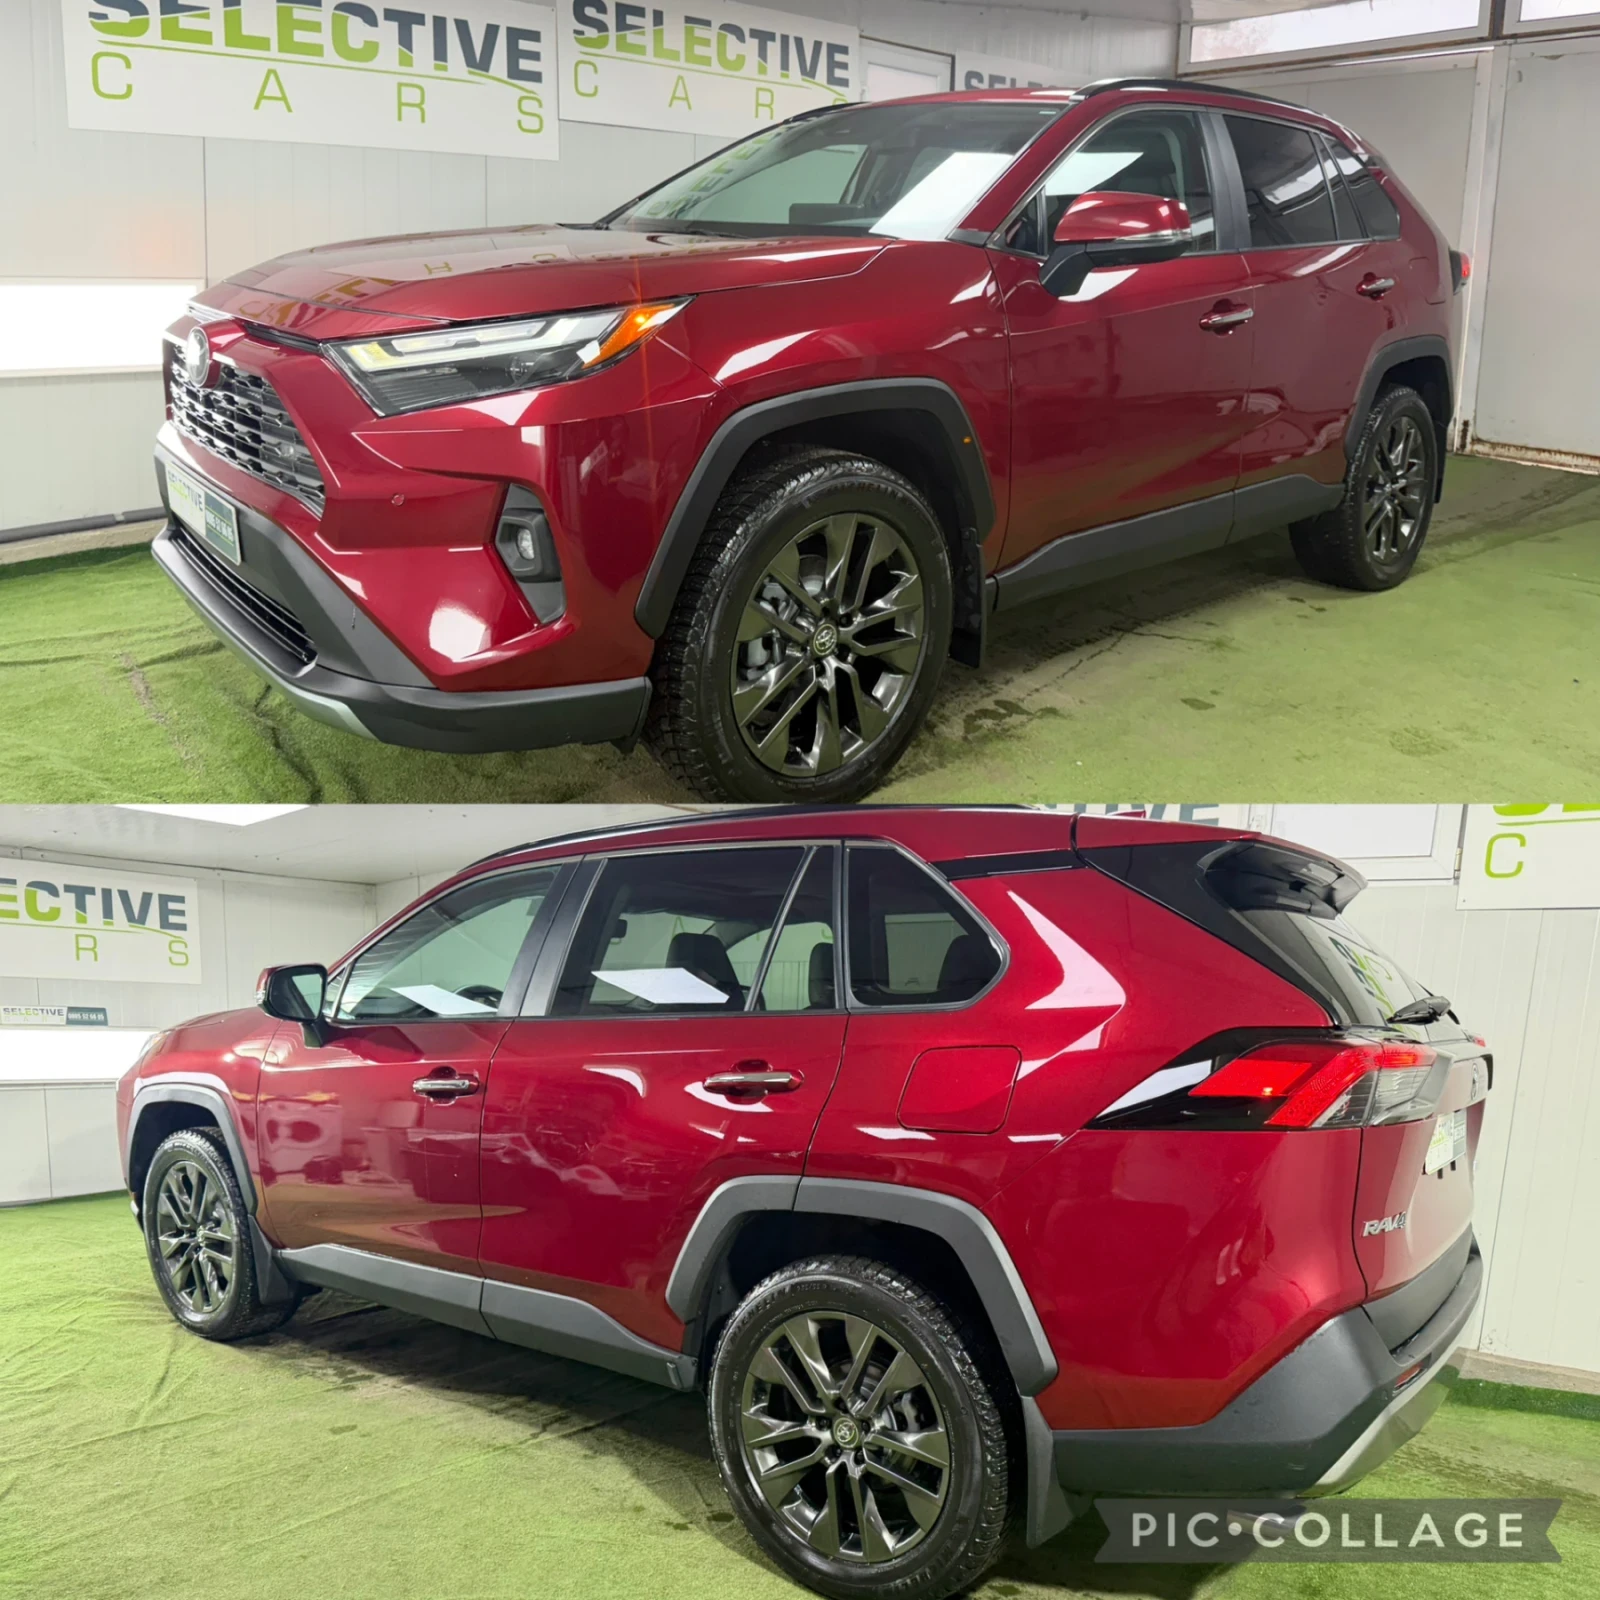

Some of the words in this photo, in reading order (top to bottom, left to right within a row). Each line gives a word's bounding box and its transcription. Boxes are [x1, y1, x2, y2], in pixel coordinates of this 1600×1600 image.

[88, 0, 544, 84] SELECTIVE
[572, 0, 850, 88] SELECTIVE
[1362, 1211, 1407, 1237] RAV4
